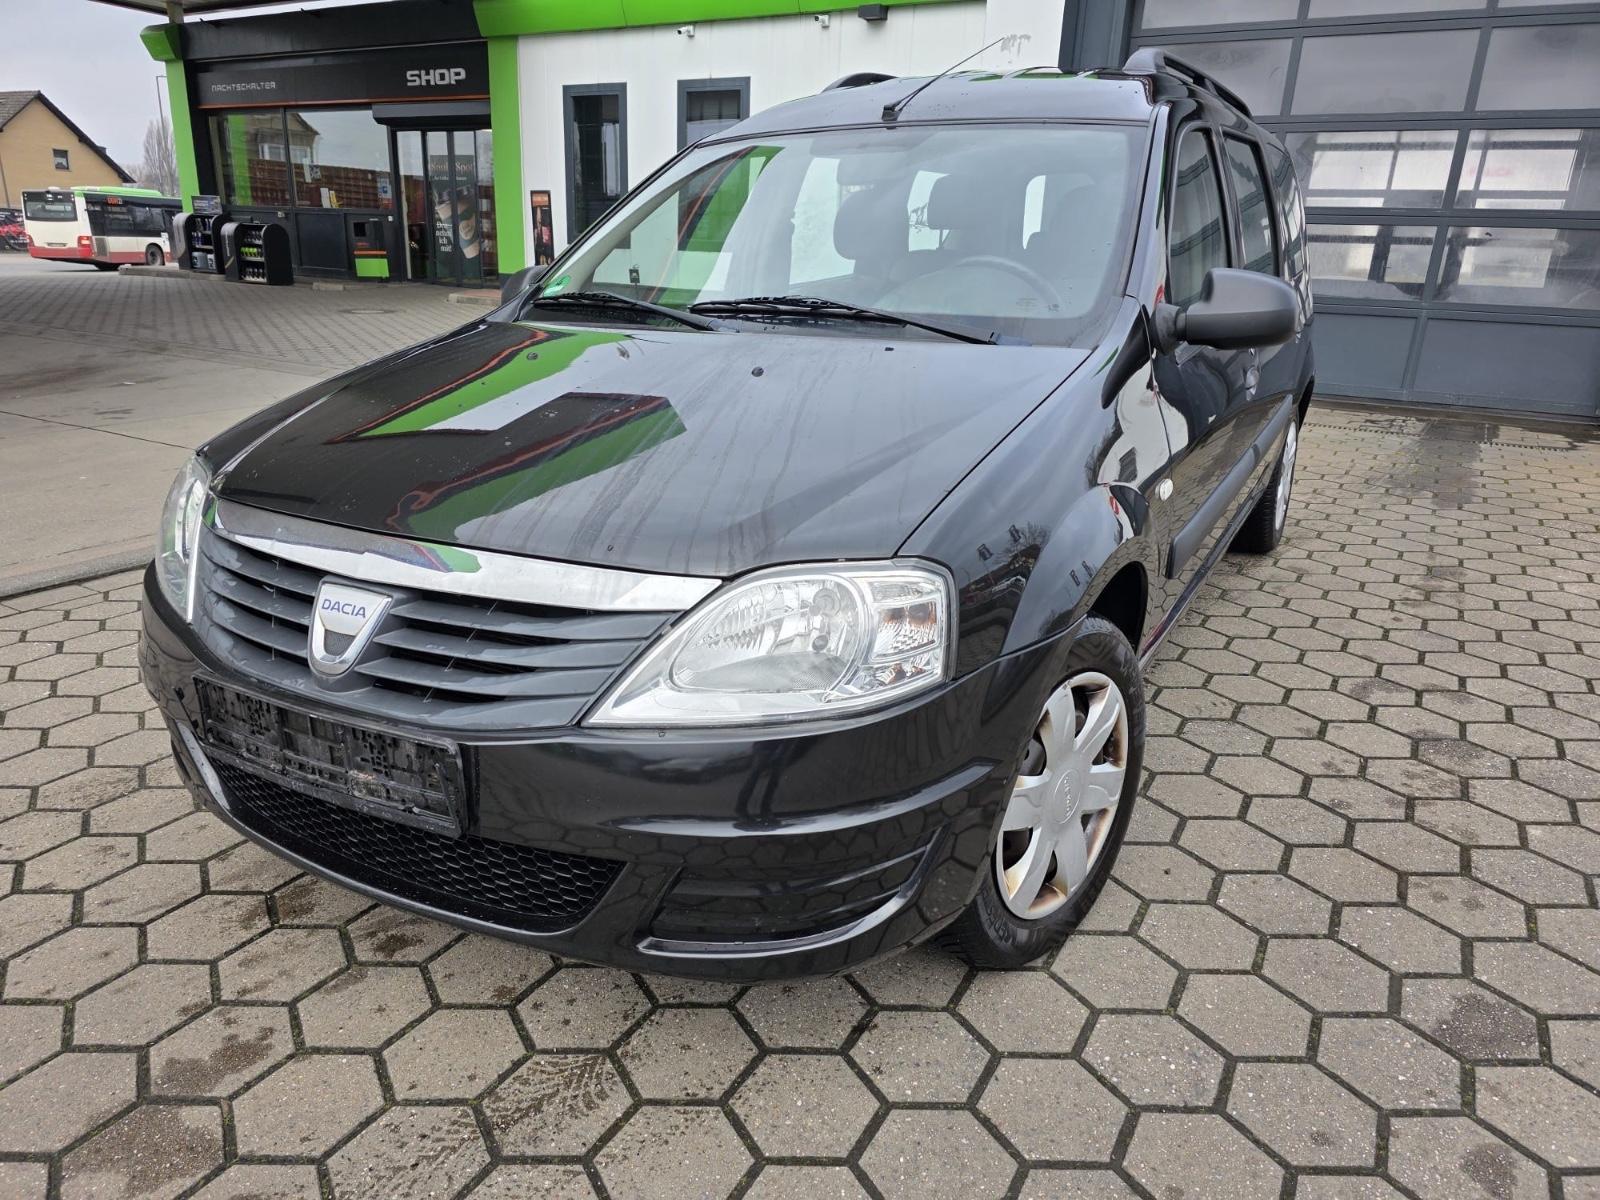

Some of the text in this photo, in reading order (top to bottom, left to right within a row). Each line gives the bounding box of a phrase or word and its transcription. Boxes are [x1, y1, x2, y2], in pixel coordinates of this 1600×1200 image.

[406, 67, 466, 86] SHOP
[211, 82, 276, 92] NACHTSCHALTER
[321, 598, 366, 618] DACIA
